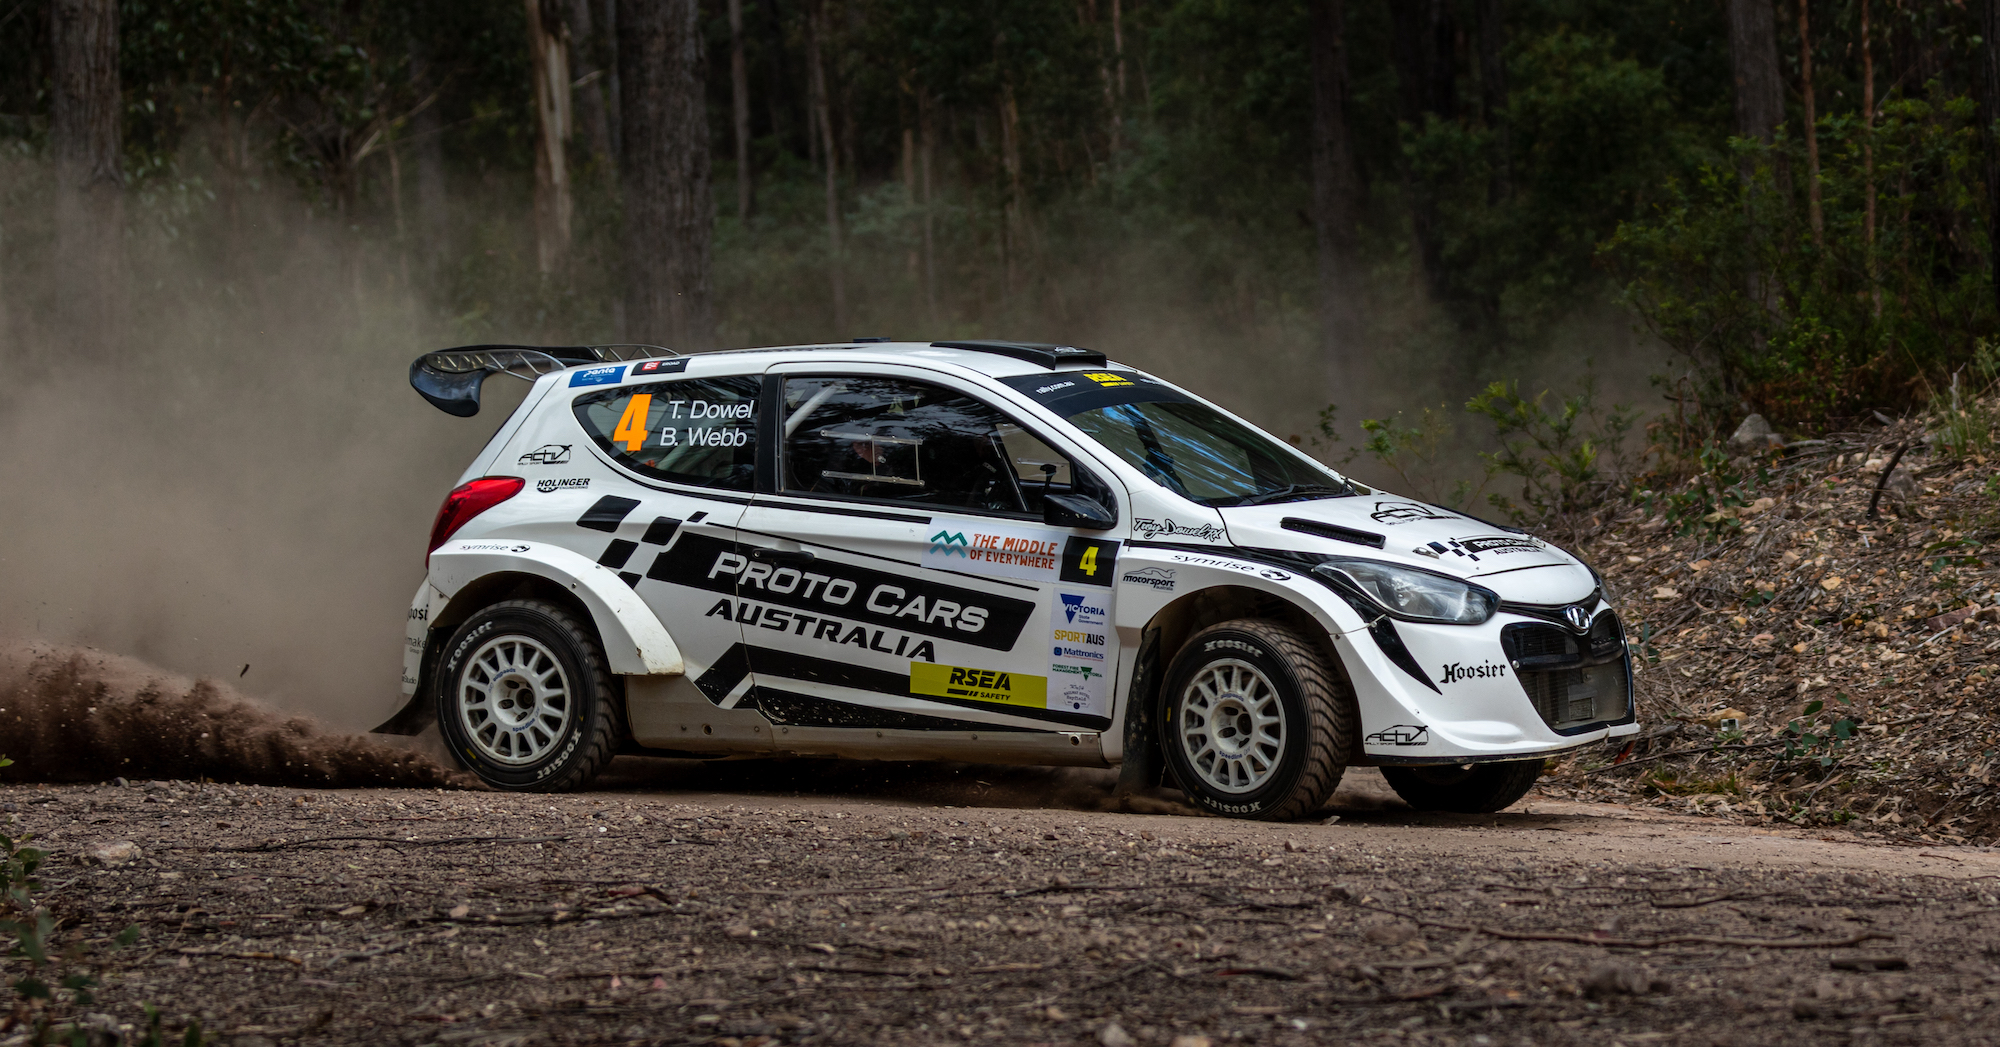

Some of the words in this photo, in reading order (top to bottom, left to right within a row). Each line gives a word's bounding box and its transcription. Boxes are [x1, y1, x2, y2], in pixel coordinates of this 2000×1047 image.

[669, 400, 685, 419] T.
[690, 400, 754, 419] Dowel
[613, 393, 652, 451] 4
[660, 427, 678, 446] B.
[688, 427, 747, 446] Webb
[537, 478, 590, 487] HOLINGER
[973, 533, 1000, 549] THE
[1002, 537, 1058, 556] MIDDLE
[970, 549, 983, 560] OF
[986, 551, 1055, 570] EVERYWHERE
[1079, 546, 1099, 576] 4
[1171, 553, 1255, 571] symrise
[1122, 575, 1175, 588] motorsport
[707, 551, 857, 605] PROTO
[866, 584, 989, 632] CARS
[1063, 603, 1105, 616] VICTORIA
[705, 598, 935, 663] AUSTRALIA
[1054, 629, 1105, 646] SPORTAUS
[1063, 647, 1104, 660] Mattronics
[949, 667, 1011, 692] RSEA
[1440, 660, 1506, 683] Hoosier
[980, 691, 1011, 701] SAFETY
